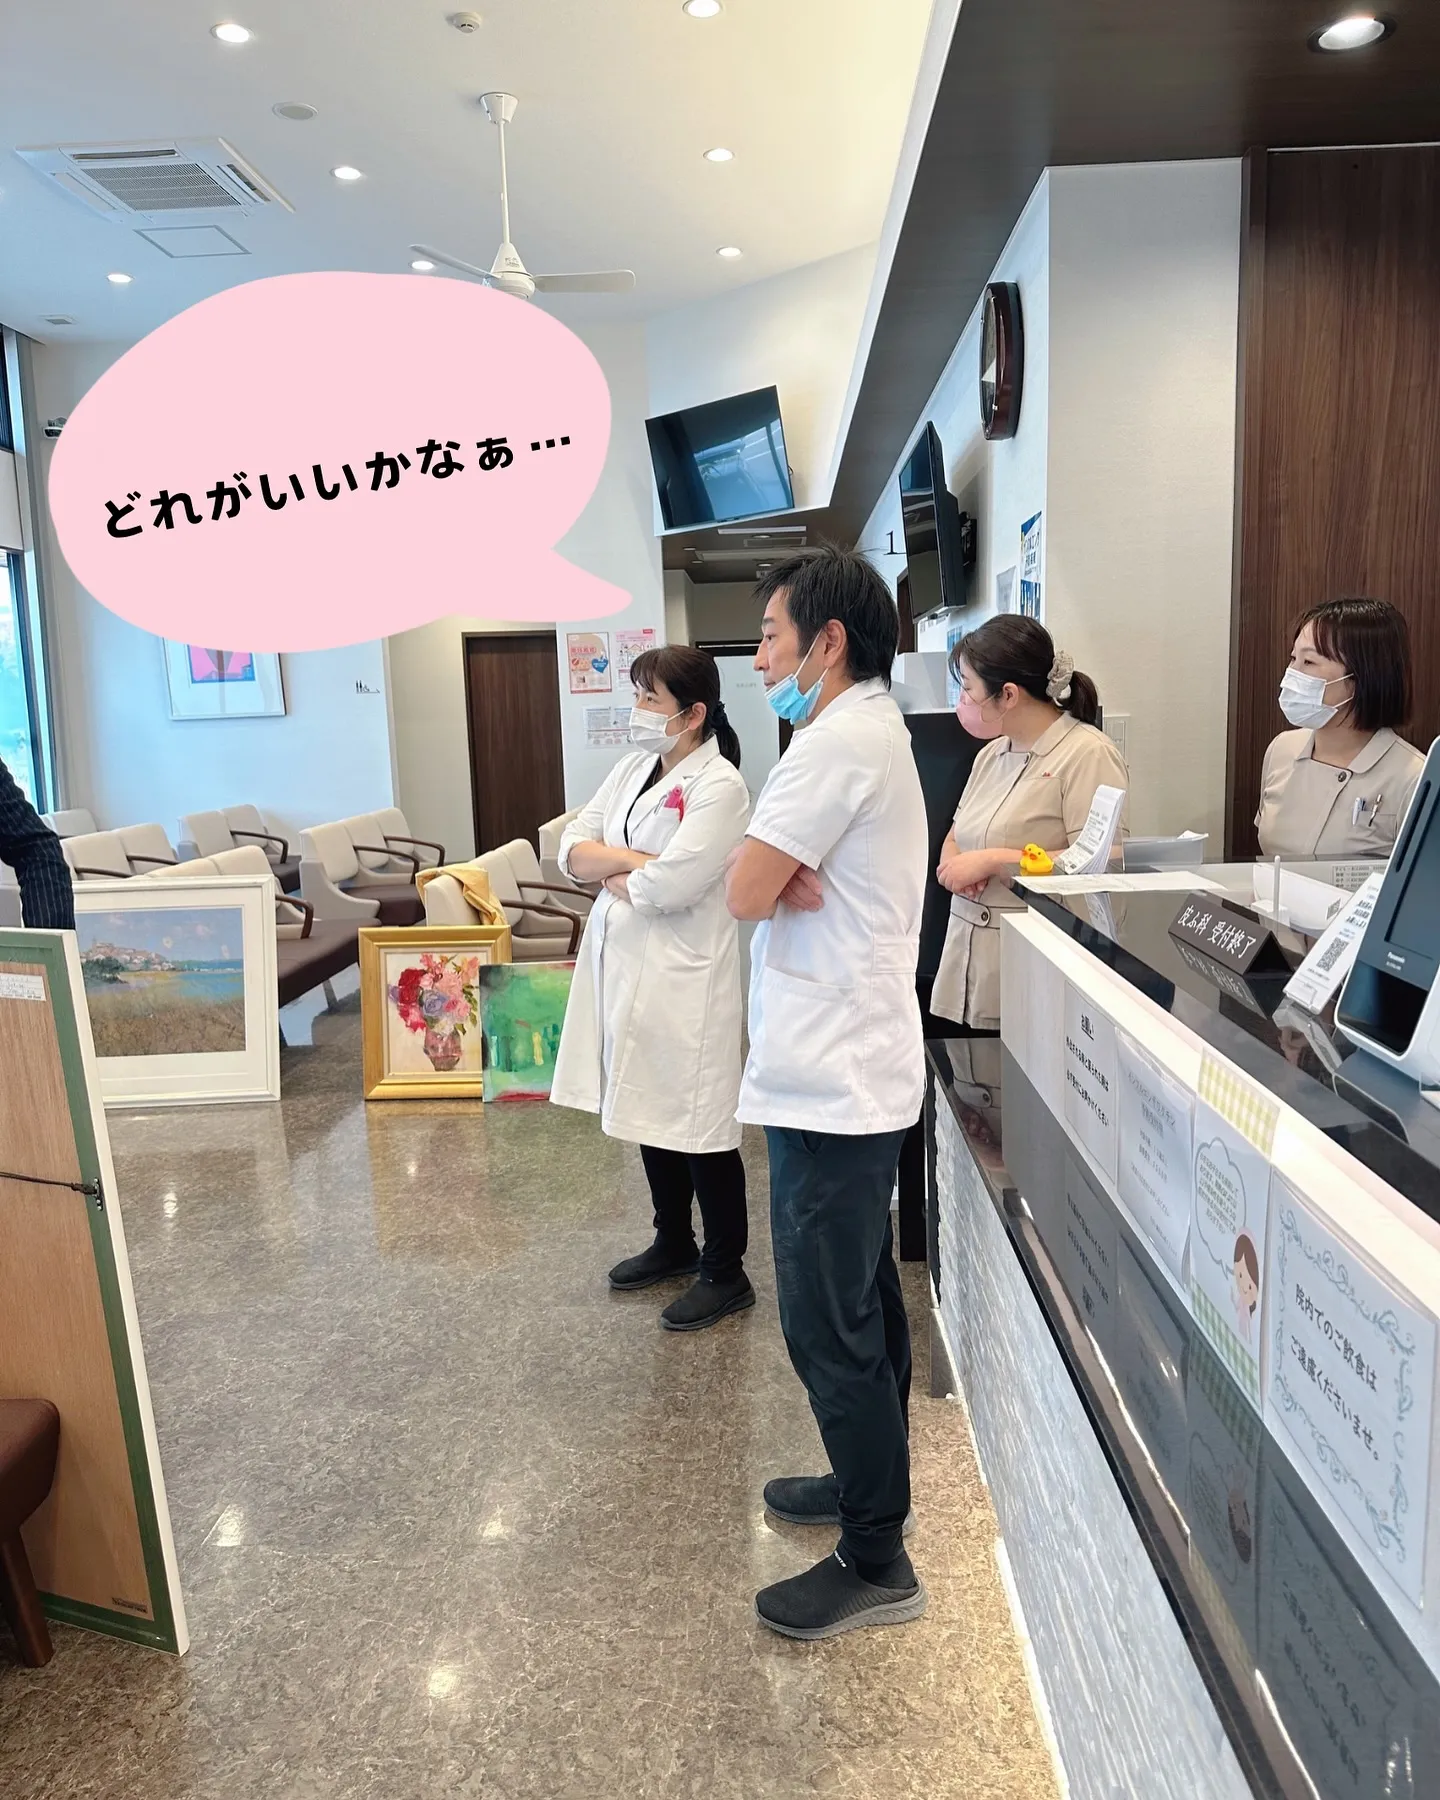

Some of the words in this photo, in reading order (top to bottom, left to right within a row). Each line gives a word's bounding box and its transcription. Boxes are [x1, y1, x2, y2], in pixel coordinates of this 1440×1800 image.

[1177, 904, 1212, 936] 皮ふ科
[1206, 921, 1257, 959] 受付終了
[1295, 1283, 1378, 1392] 院内でのご飲食は
[1291, 1334, 1380, 1462] ご遠慮くださいませ。
